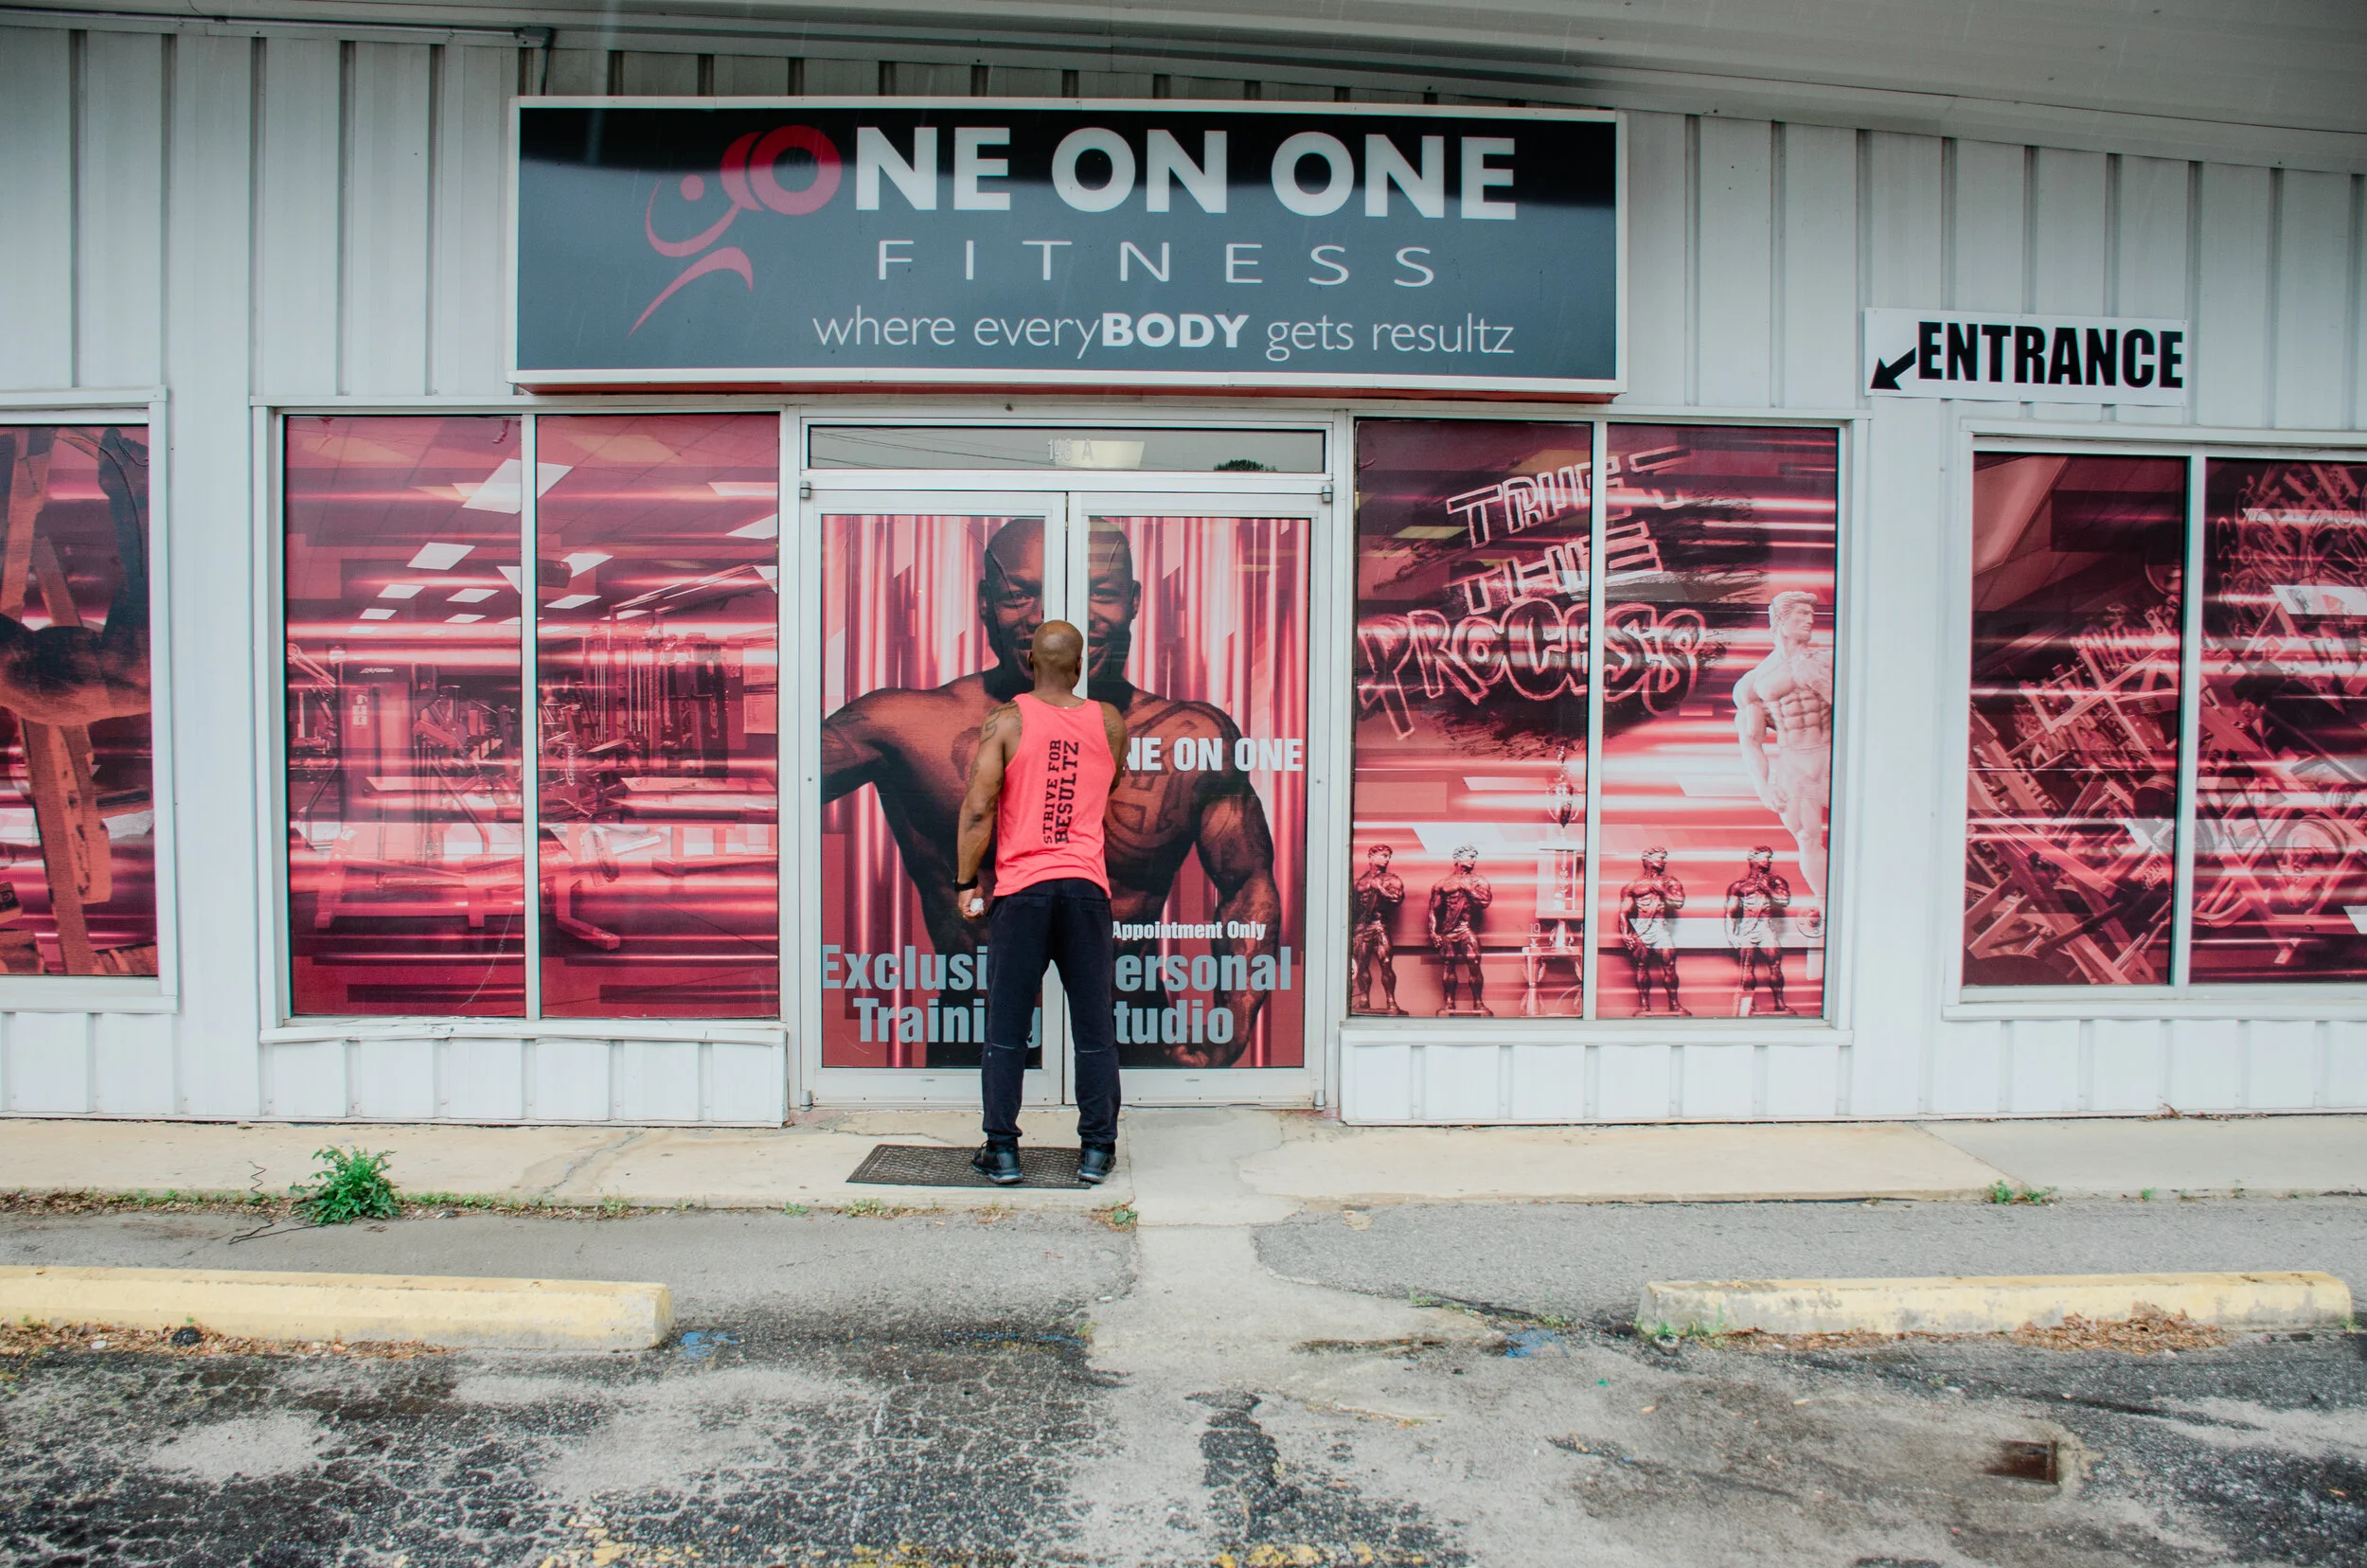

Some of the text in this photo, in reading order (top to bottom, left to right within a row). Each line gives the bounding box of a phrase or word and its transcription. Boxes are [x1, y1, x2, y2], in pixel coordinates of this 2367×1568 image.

[749, 124, 1516, 220] ONE ON ONE
[878, 241, 1435, 287] FITNESS
[812, 305, 1514, 361] where everyBODY gets resultz
[1917, 321, 2183, 388] ENTRANCE
[1123, 737, 1304, 772] NE ON ONE
[1043, 739, 1061, 844] STRIVE FOR
[1055, 740, 1079, 844] RESULTZ
[1112, 920, 1267, 941] Appointment Only
[822, 944, 1291, 992] Exclusi ersonal
[1112, 999, 1235, 1044] tudio
